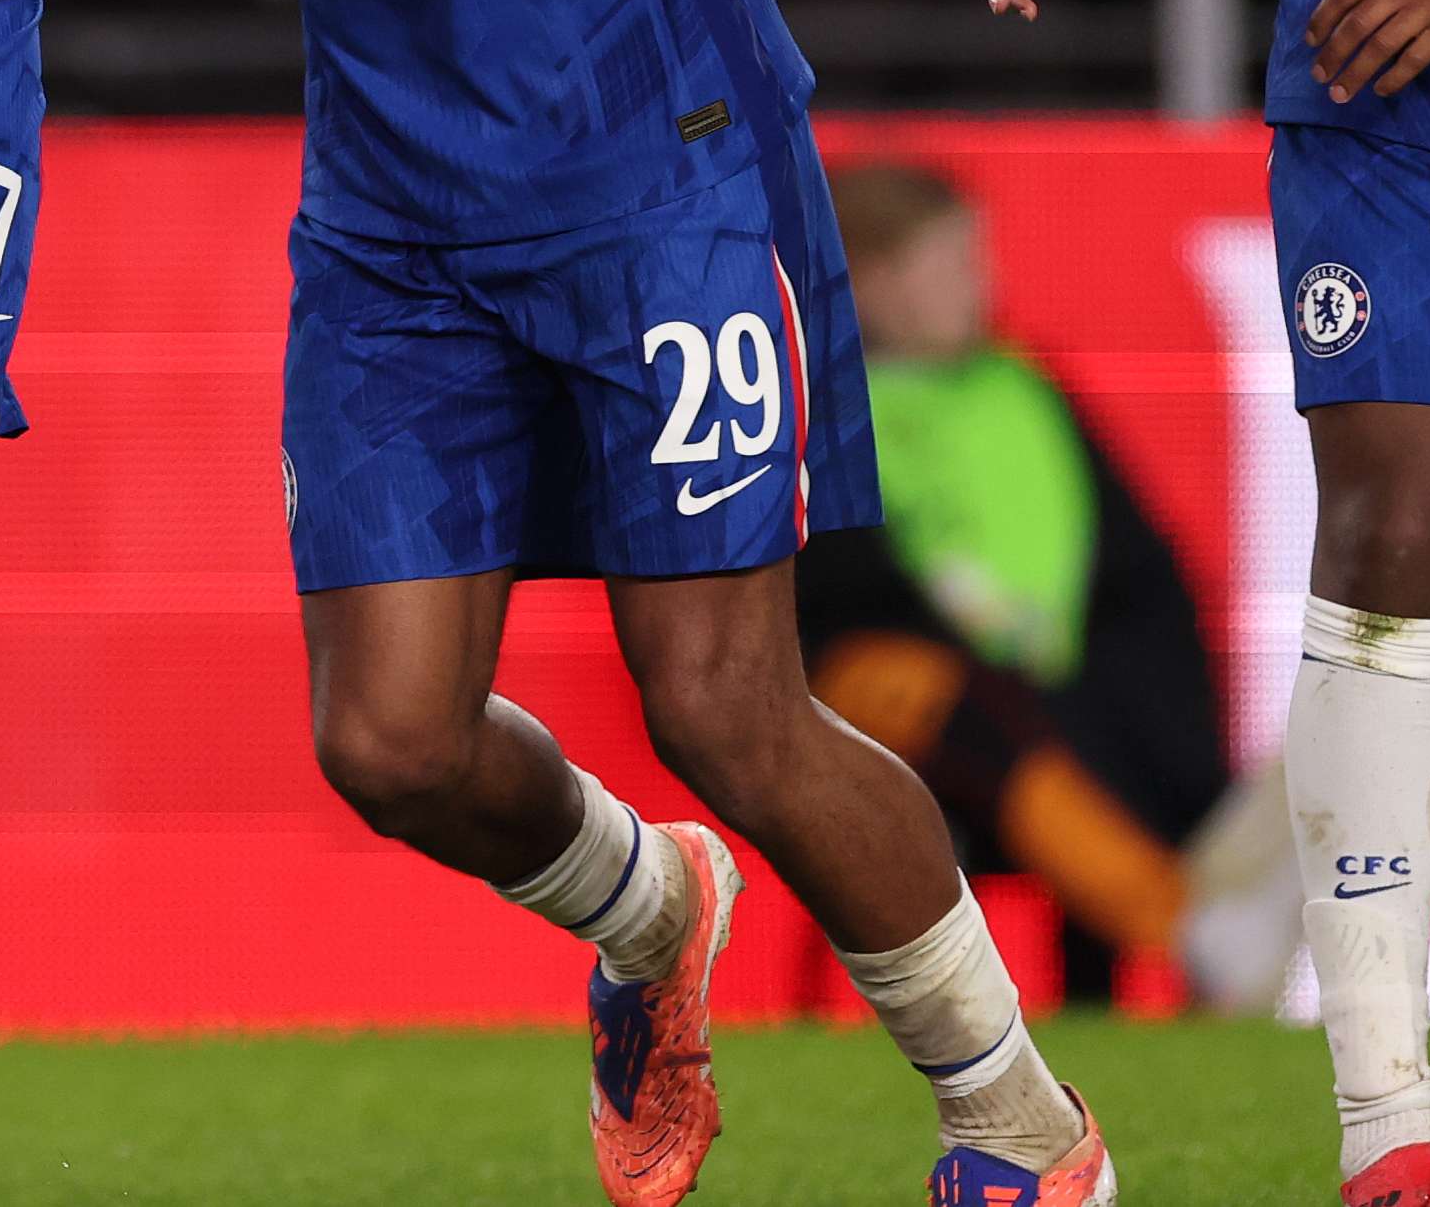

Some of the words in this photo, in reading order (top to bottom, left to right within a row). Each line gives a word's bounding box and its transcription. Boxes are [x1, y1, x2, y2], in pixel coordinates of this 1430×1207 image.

[1302, 267, 1351, 291] CHELSEA
[643, 312, 781, 464] 29
[1336, 856, 1412, 875] CFC
